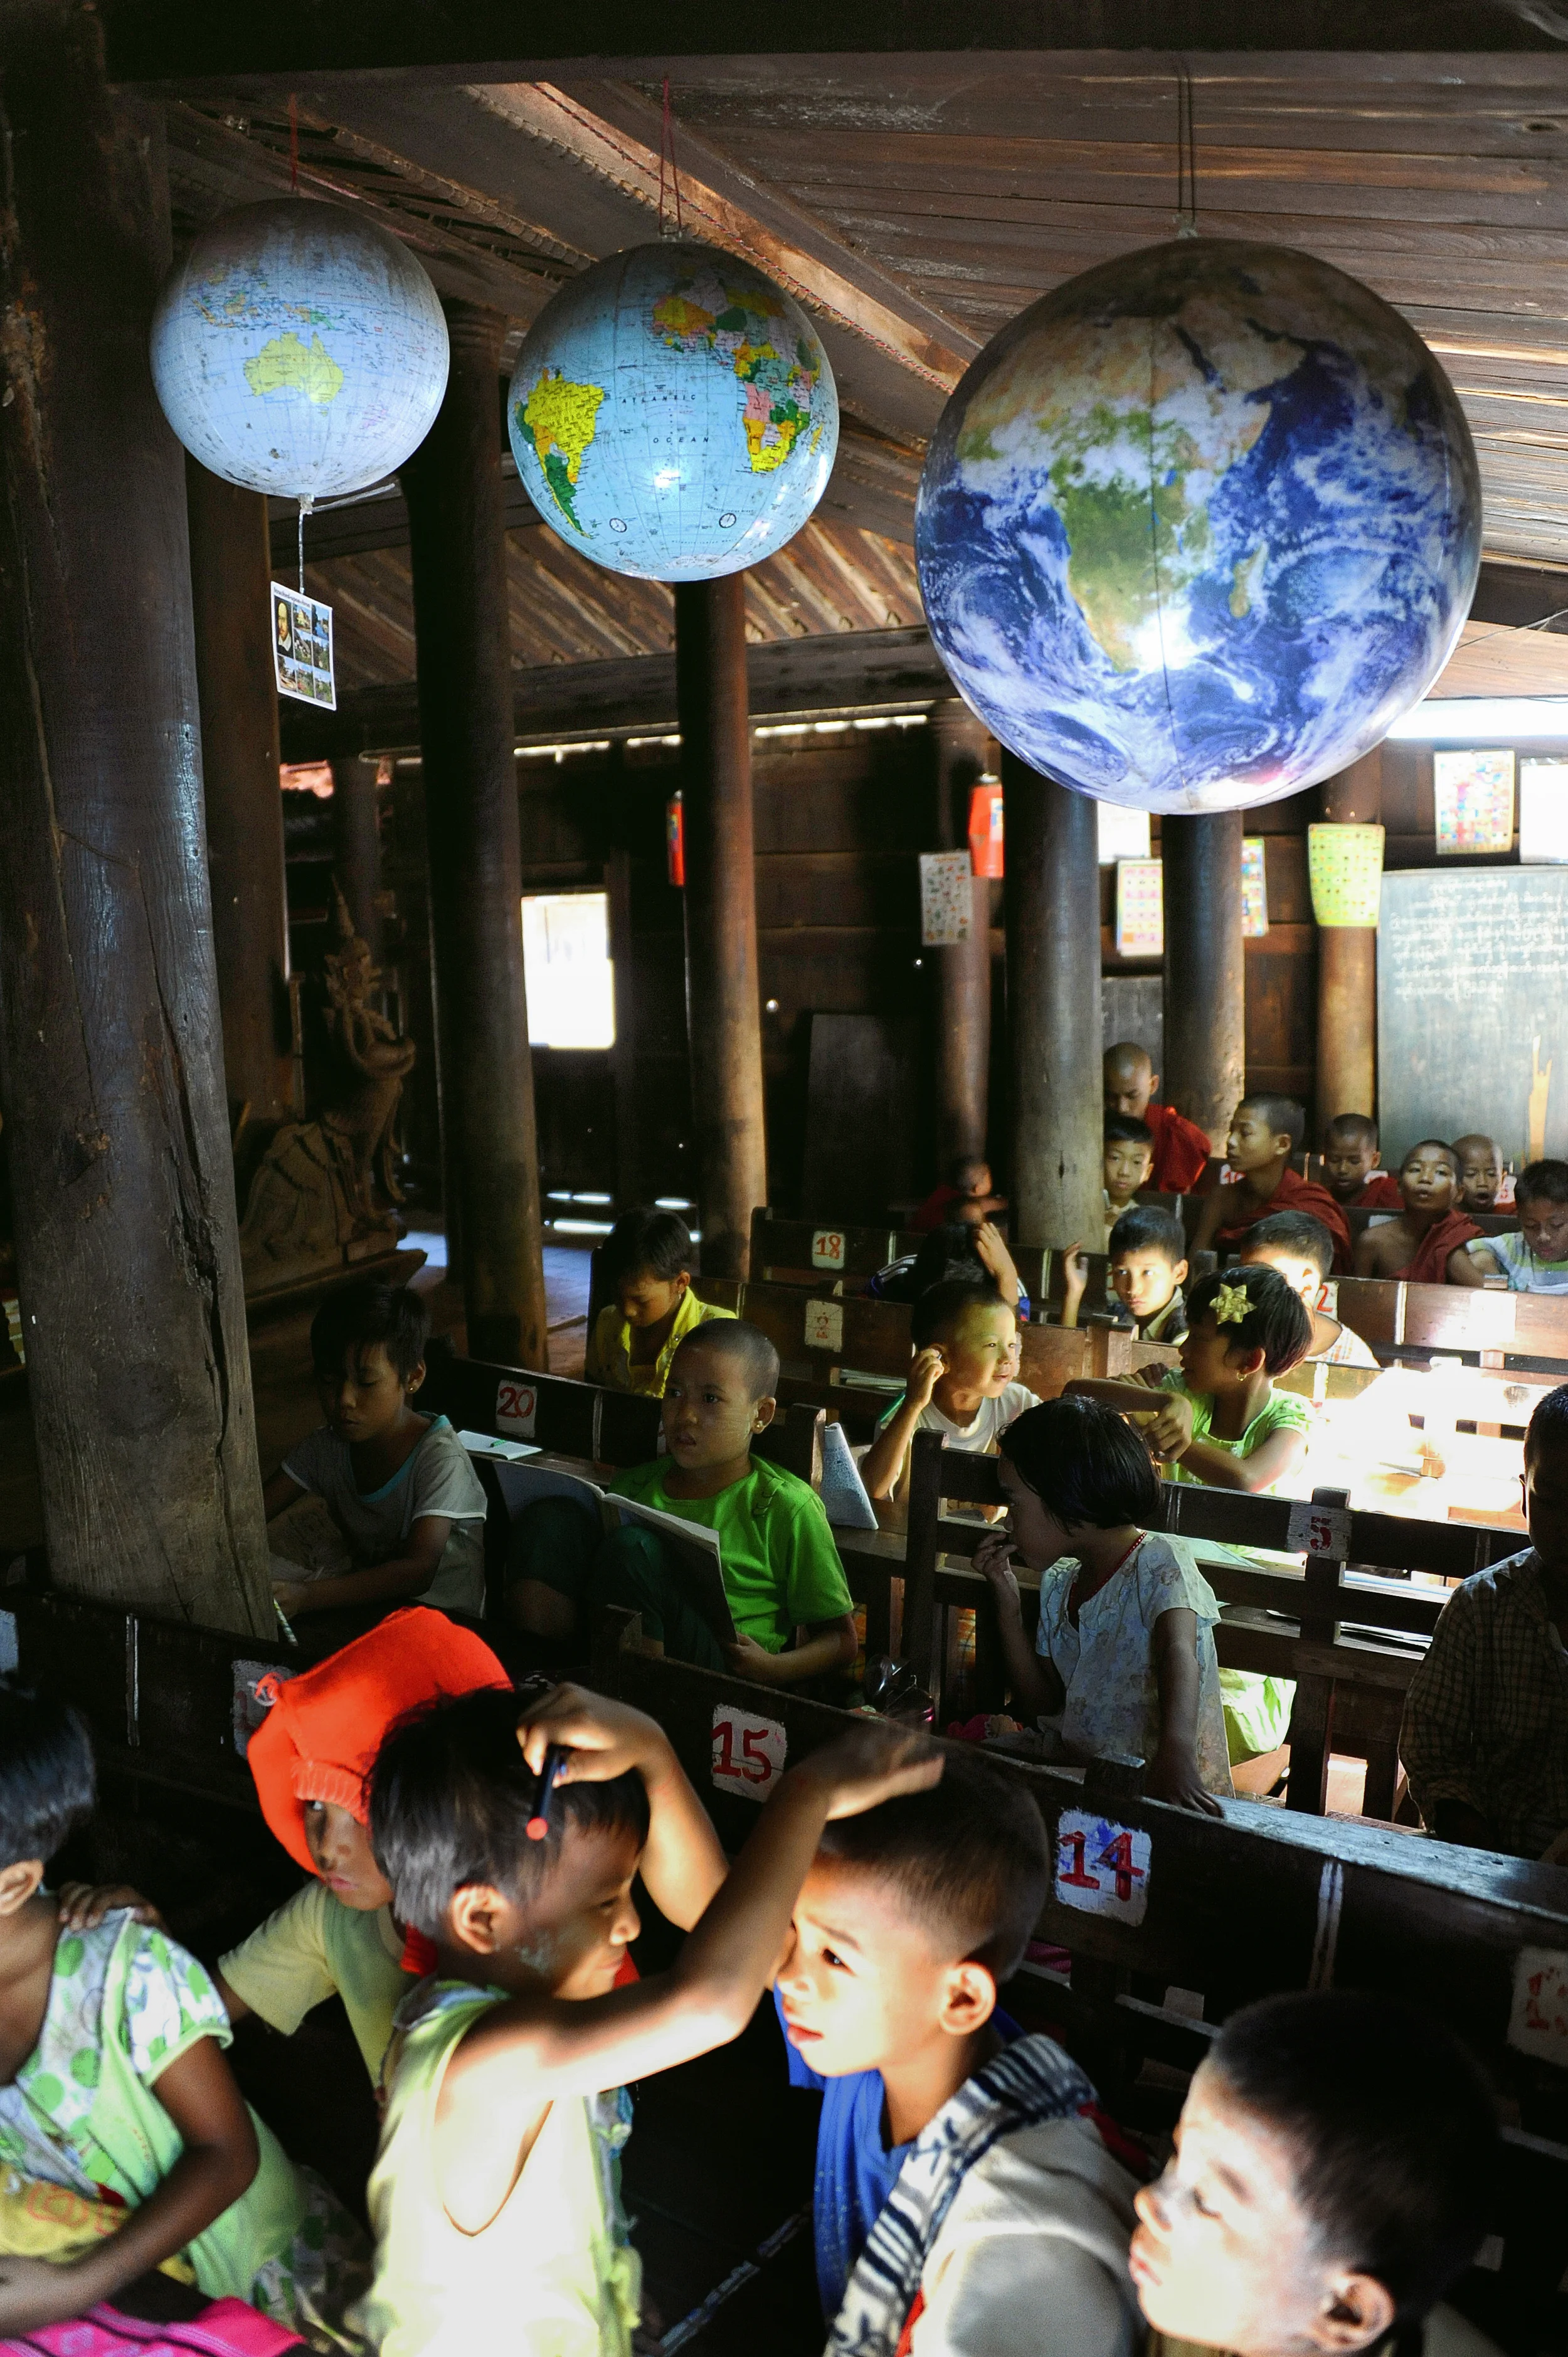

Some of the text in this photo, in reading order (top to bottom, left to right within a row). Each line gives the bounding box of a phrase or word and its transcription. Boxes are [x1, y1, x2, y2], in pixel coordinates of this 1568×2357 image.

[622, 394, 696, 403] ATLANTIC
[816, 1234, 842, 1260] 18
[1316, 1284, 1333, 1312] 2
[497, 1386, 534, 1418] 20
[1310, 1516, 1332, 1550] 5
[710, 1721, 772, 1784] 15
[1057, 1831, 1145, 1902] 14
